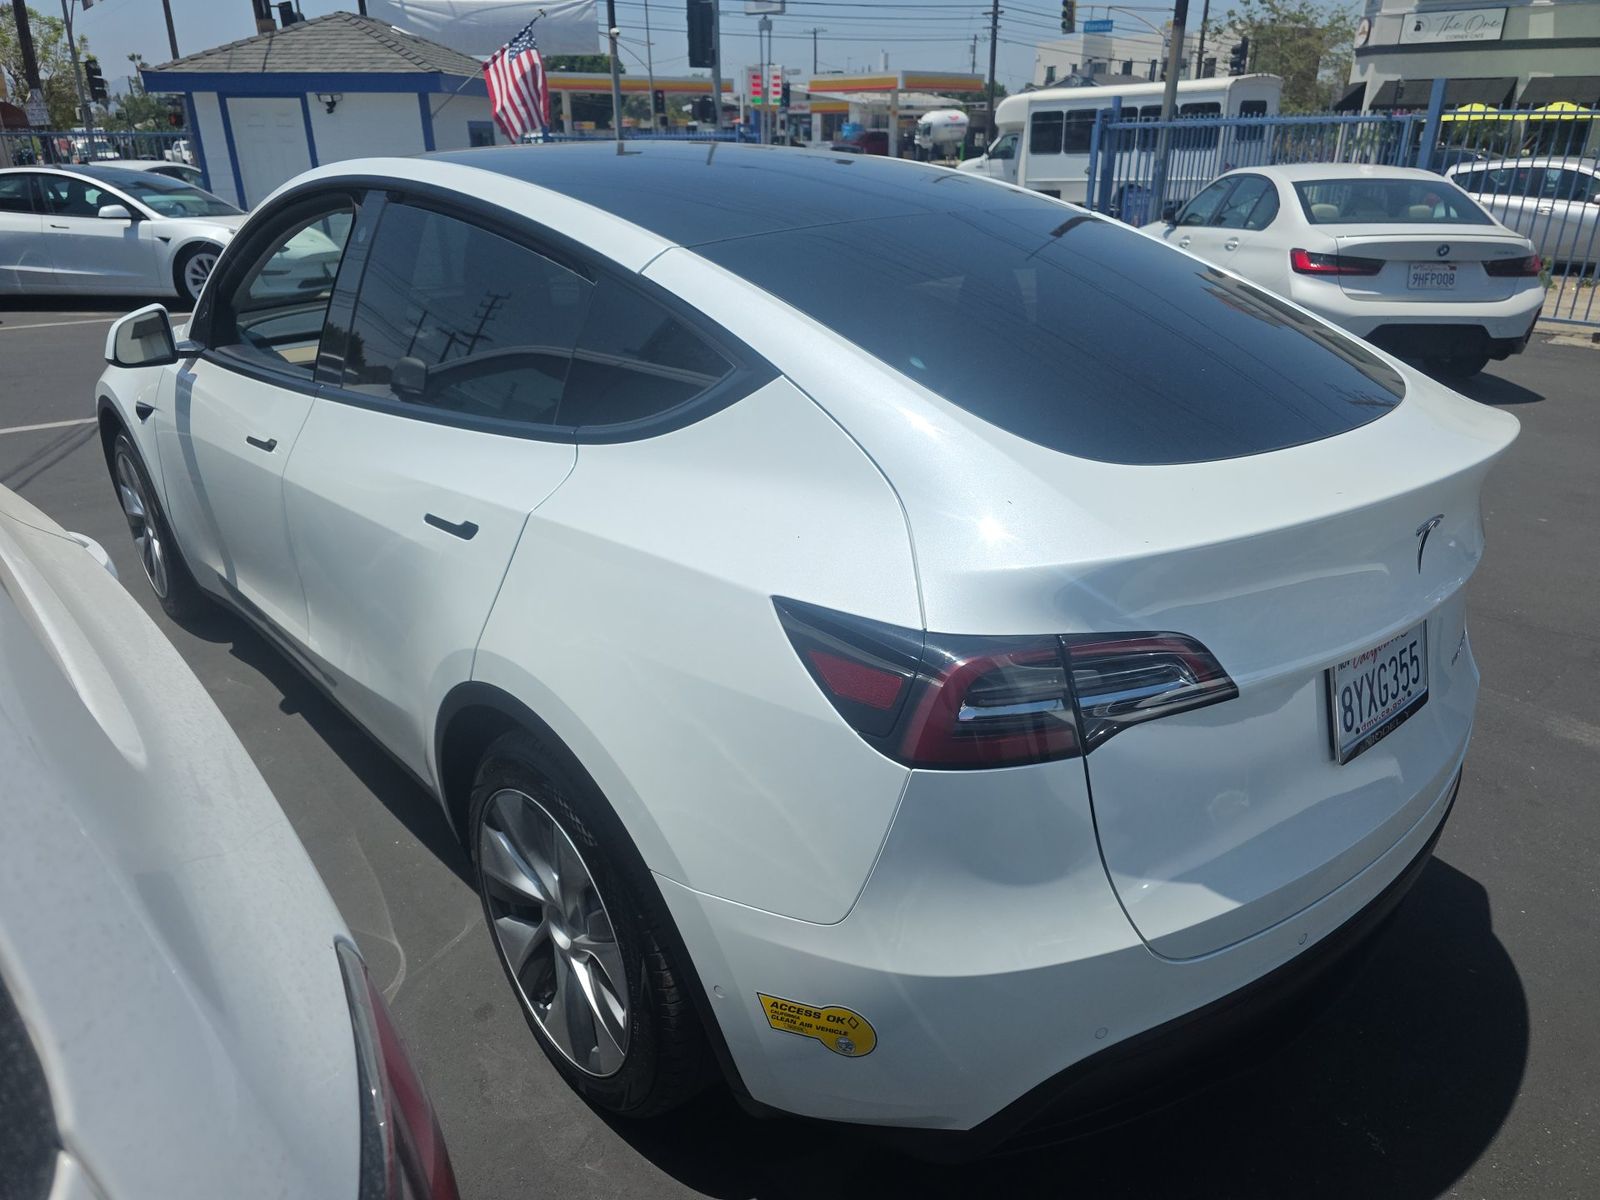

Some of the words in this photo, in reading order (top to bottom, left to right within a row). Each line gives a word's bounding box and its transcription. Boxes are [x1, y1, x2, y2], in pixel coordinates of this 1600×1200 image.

[1435, 14, 1461, 36] The
[1464, 15, 1501, 33] One
[1341, 640, 1420, 733] 8YXG355
[770, 1001, 822, 1019] ACCESS
[827, 1015, 847, 1025] OK
[771, 1014, 797, 1025] CLEAN
[815, 1025, 849, 1036] VEHICLE
